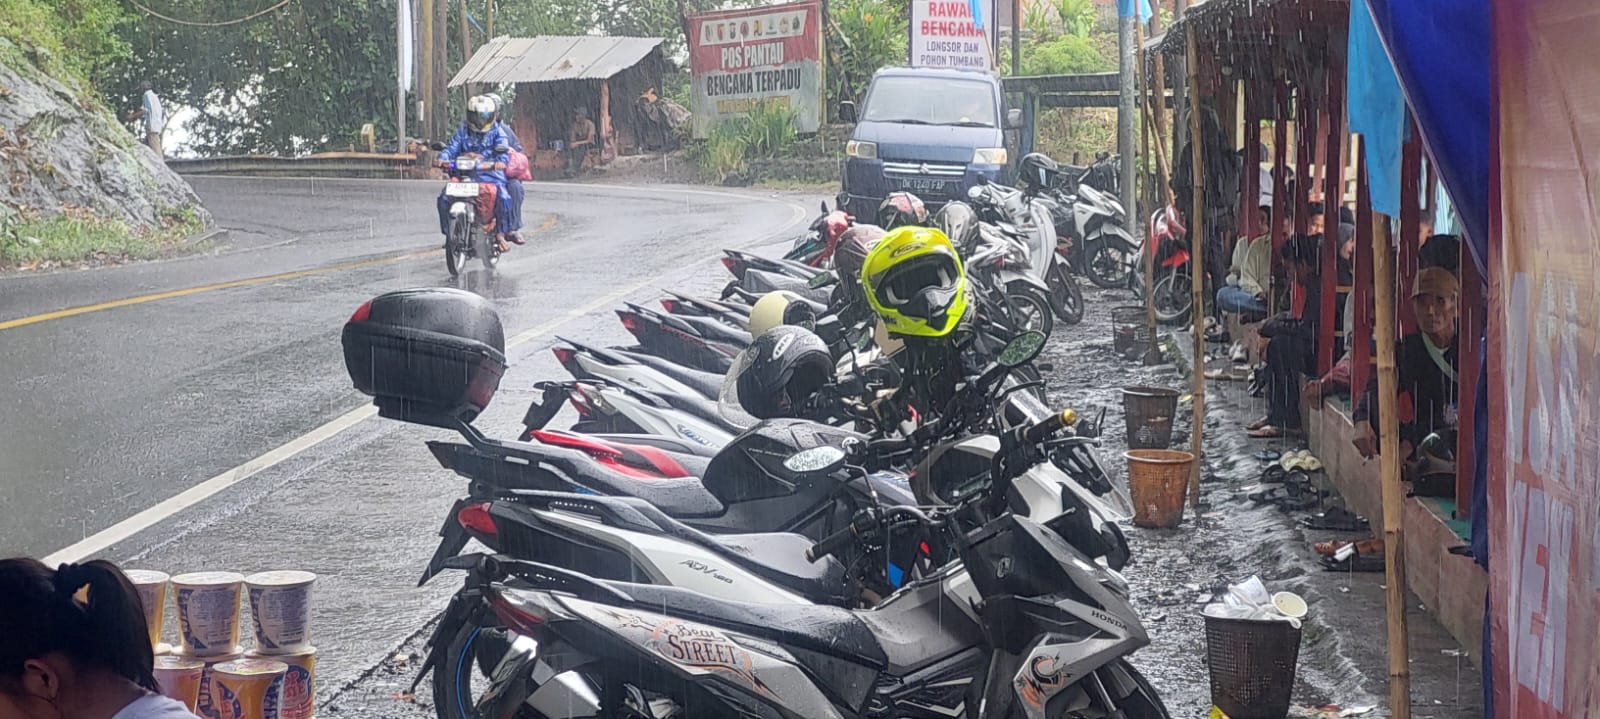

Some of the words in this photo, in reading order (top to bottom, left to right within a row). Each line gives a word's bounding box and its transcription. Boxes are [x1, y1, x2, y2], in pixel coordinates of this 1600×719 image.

[921, 20, 983, 37] BENCANA
[721, 46, 742, 69] POS
[743, 41, 784, 67] PANTAU
[926, 41, 961, 53] LONGSOR
[964, 42, 979, 53] DAN
[920, 54, 947, 66] POHON
[949, 55, 984, 67] TUMBANG
[706, 71, 754, 97] BENCANA
[755, 67, 801, 93] TERPADU
[679, 559, 718, 574] ADV
[1091, 610, 1127, 630] HONDA
[668, 634, 737, 665] STREET
